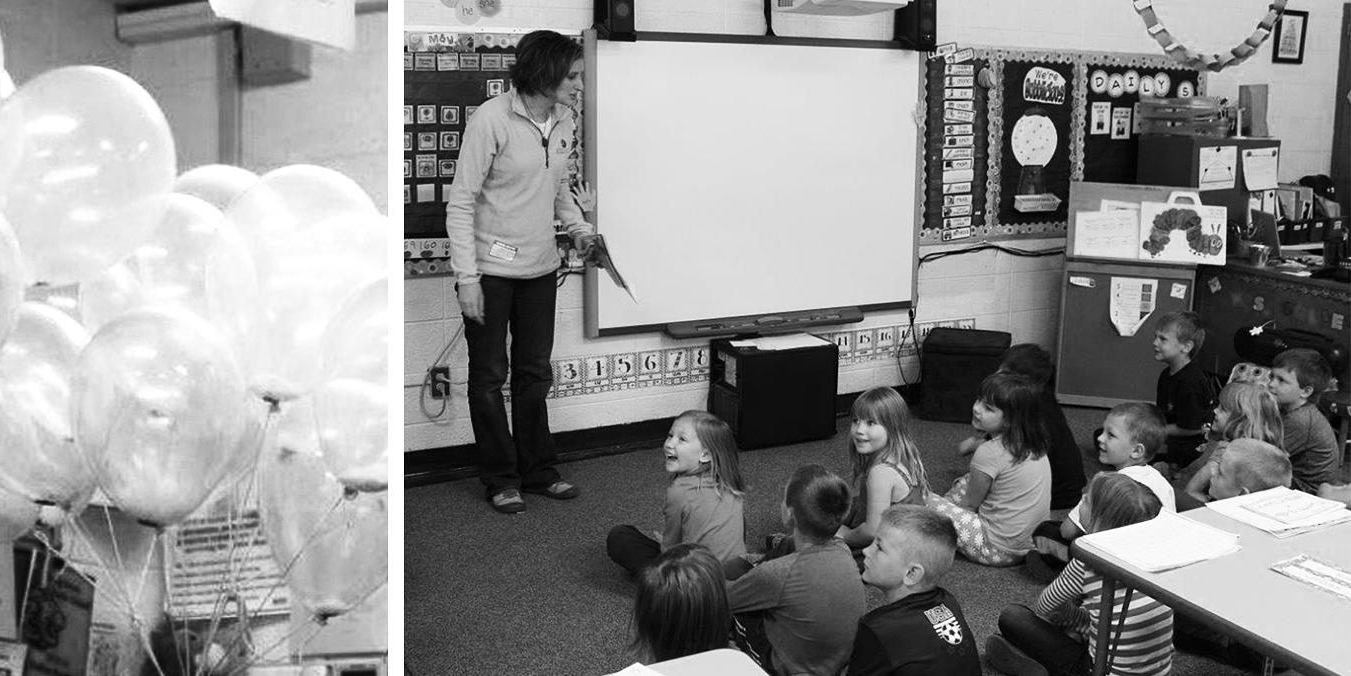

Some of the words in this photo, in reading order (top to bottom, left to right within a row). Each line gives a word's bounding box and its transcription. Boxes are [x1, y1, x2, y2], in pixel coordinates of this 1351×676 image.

[1095, 77, 1165, 93] DAILY
[563, 362, 578, 380] 3
[618, 356, 632, 374] 5
[644, 353, 657, 371] 6
[670, 351, 683, 368] 7
[924, 604, 954, 624] USA
